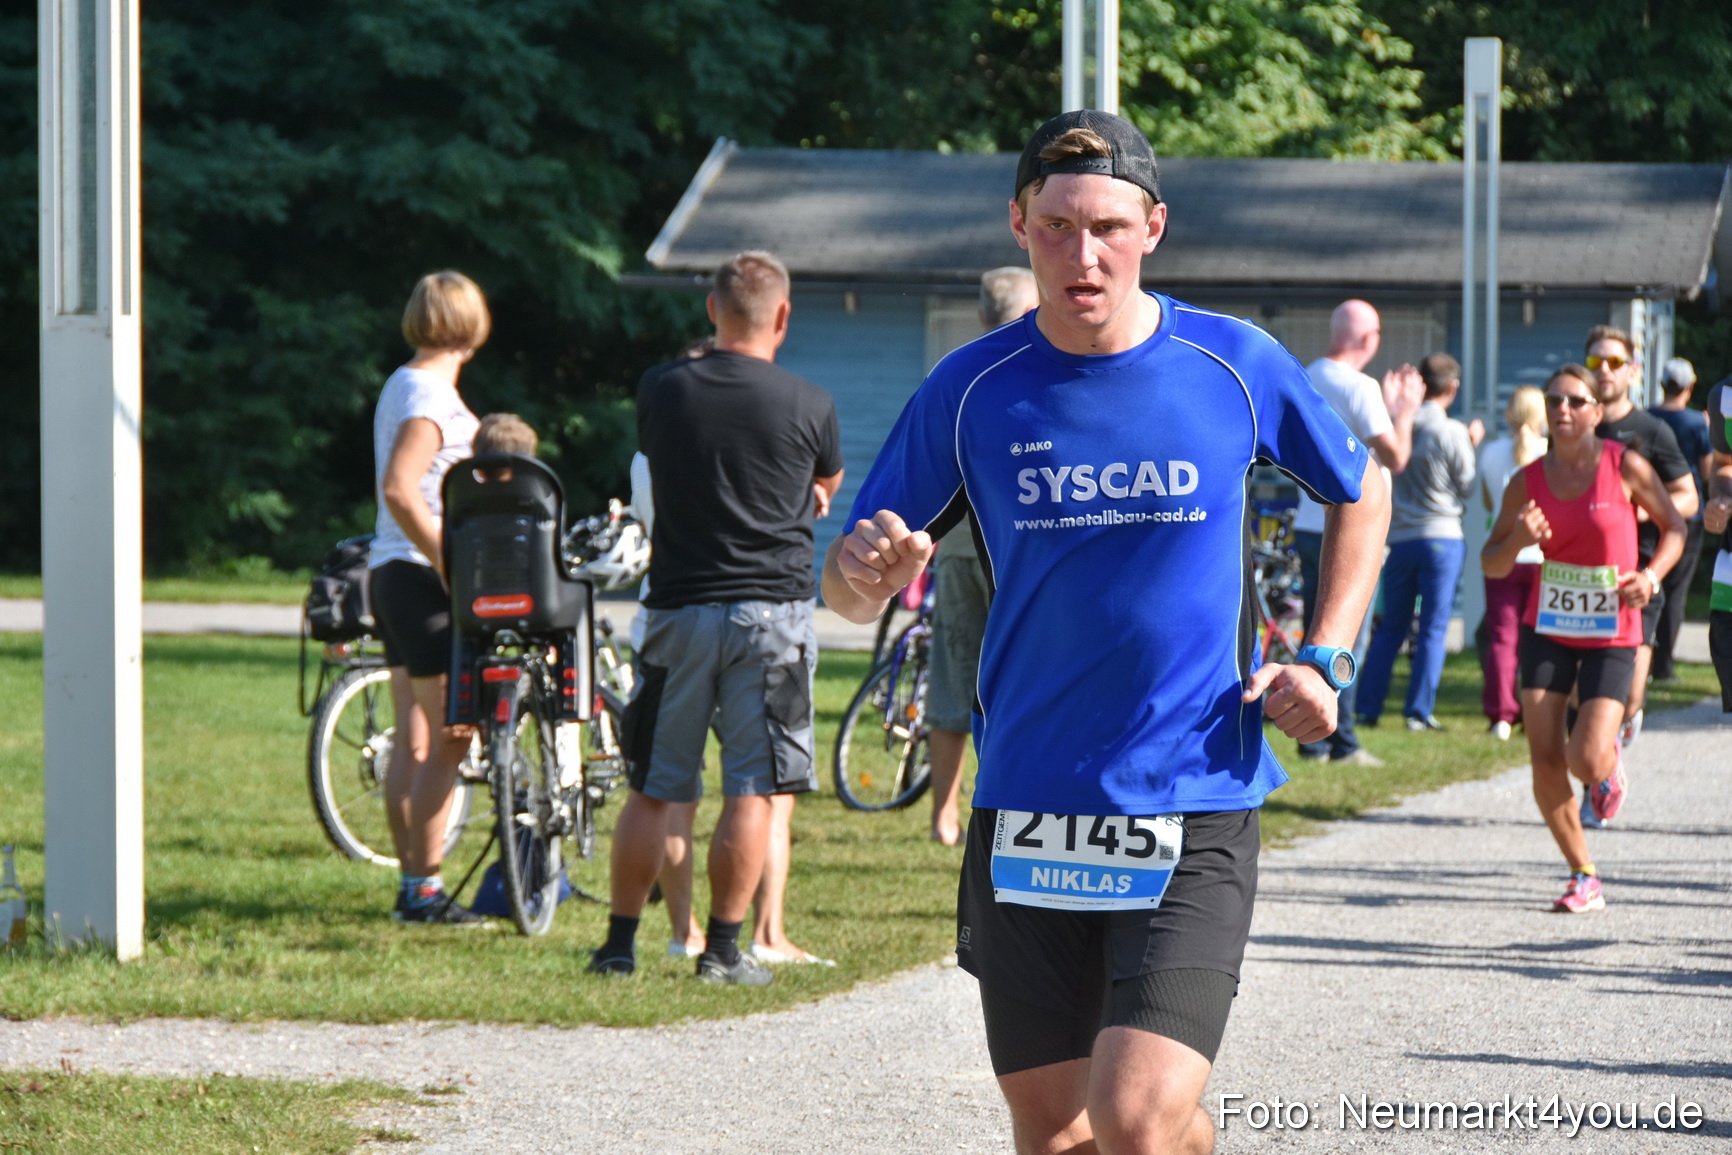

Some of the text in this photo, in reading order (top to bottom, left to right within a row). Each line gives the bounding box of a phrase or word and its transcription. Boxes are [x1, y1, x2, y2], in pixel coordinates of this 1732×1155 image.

[1024, 440, 1053, 453] JAKO
[1017, 460, 1199, 505] SYSCAD
[1014, 507, 1207, 530] www.metallbau-cad.de
[1548, 587, 1607, 612] 2612
[1013, 812, 1157, 859] 2145
[1031, 866, 1133, 894] NIKLAS
